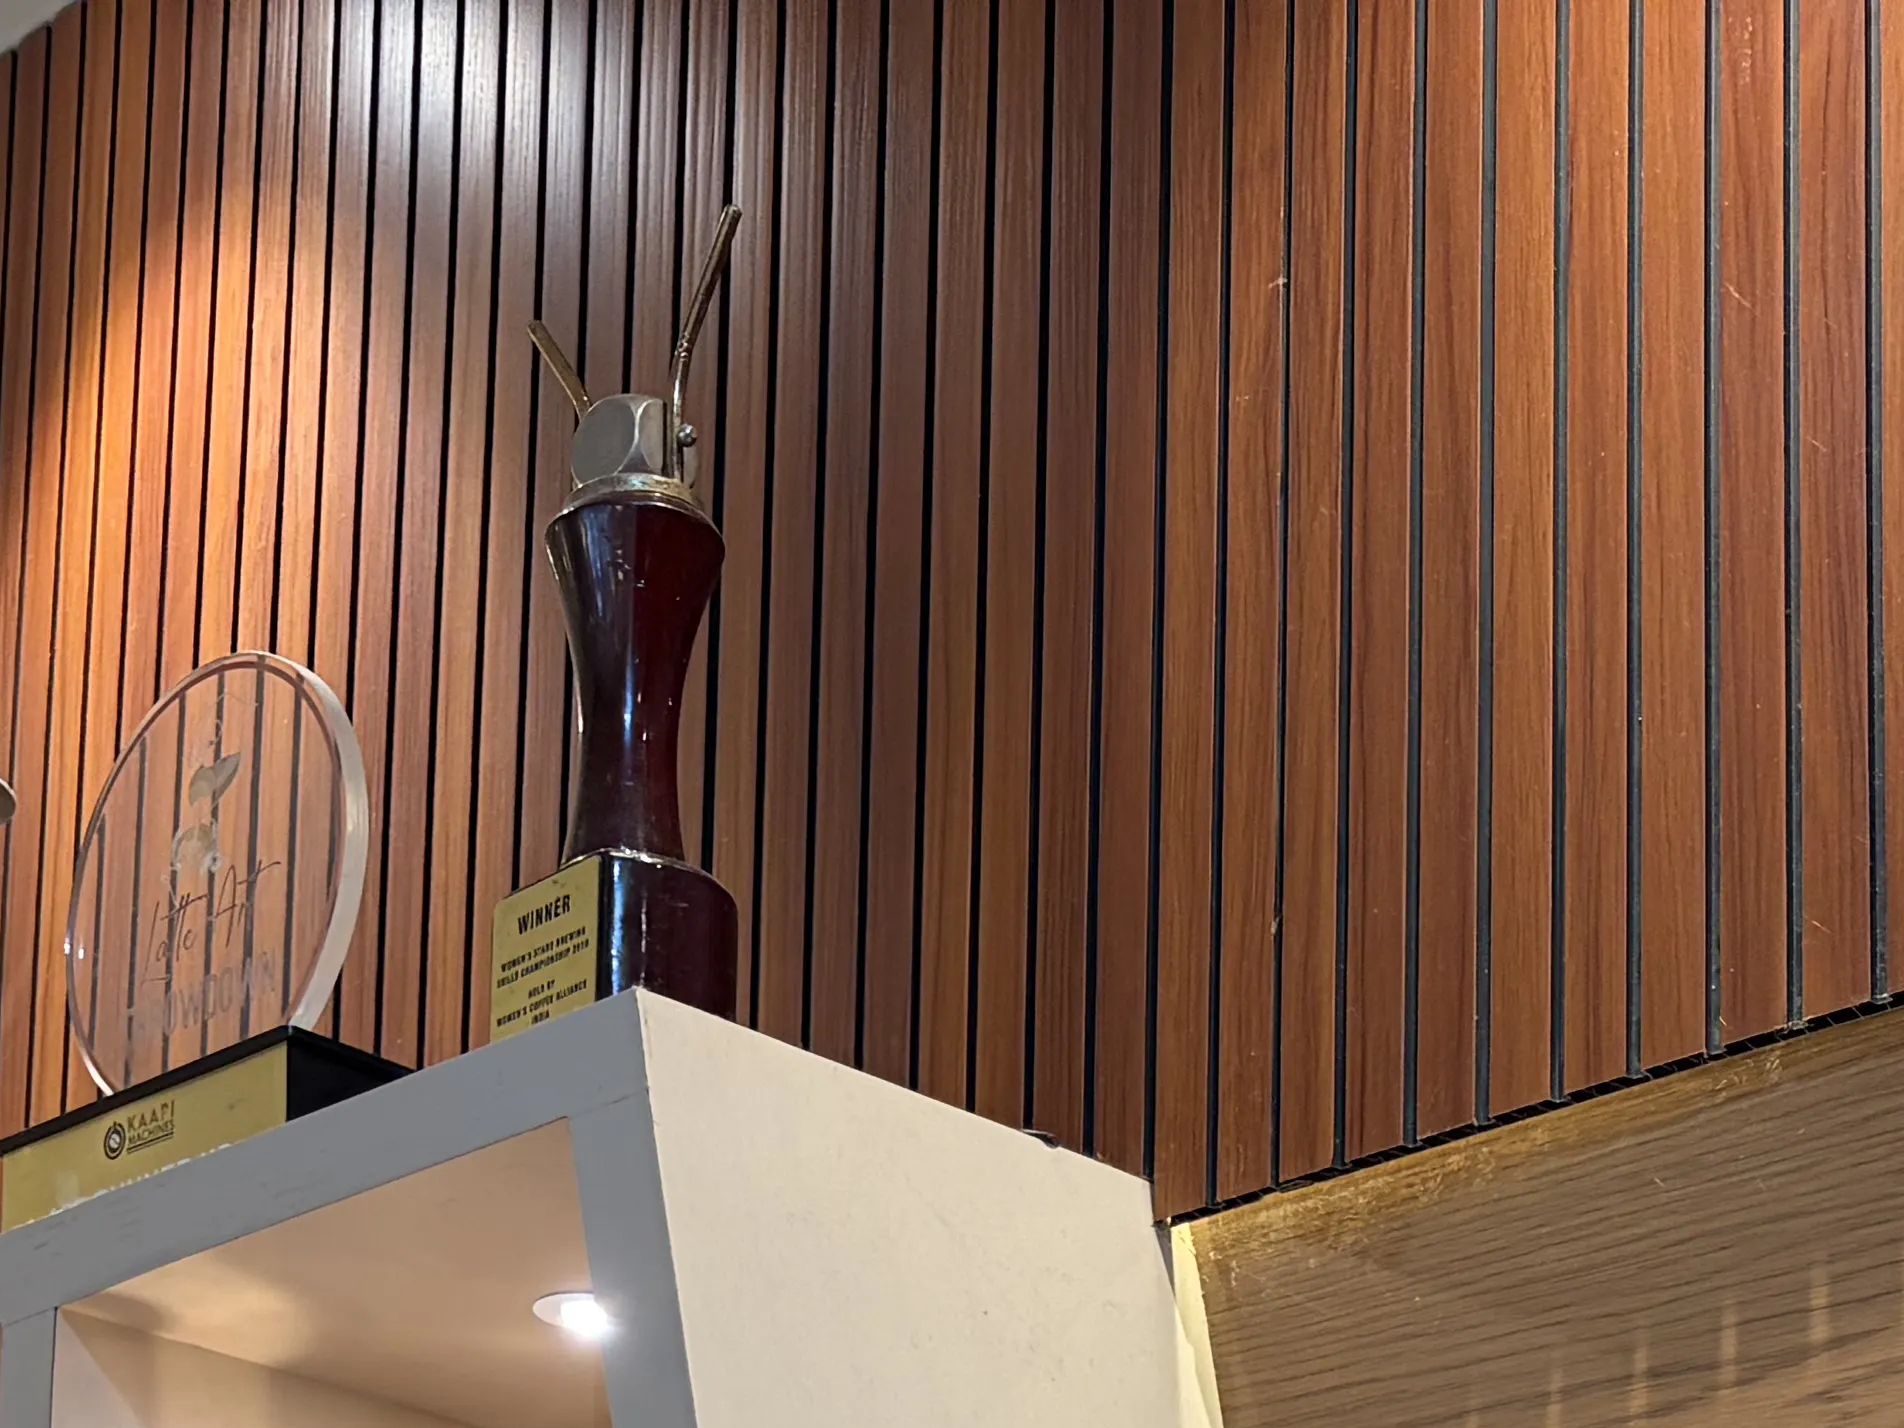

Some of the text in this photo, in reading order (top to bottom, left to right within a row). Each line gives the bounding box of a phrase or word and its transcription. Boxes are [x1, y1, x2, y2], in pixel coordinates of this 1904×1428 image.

[517, 894, 571, 935] WINNER
[127, 1100, 175, 1131] KAAPI
[127, 1119, 175, 1145] MACHINES
